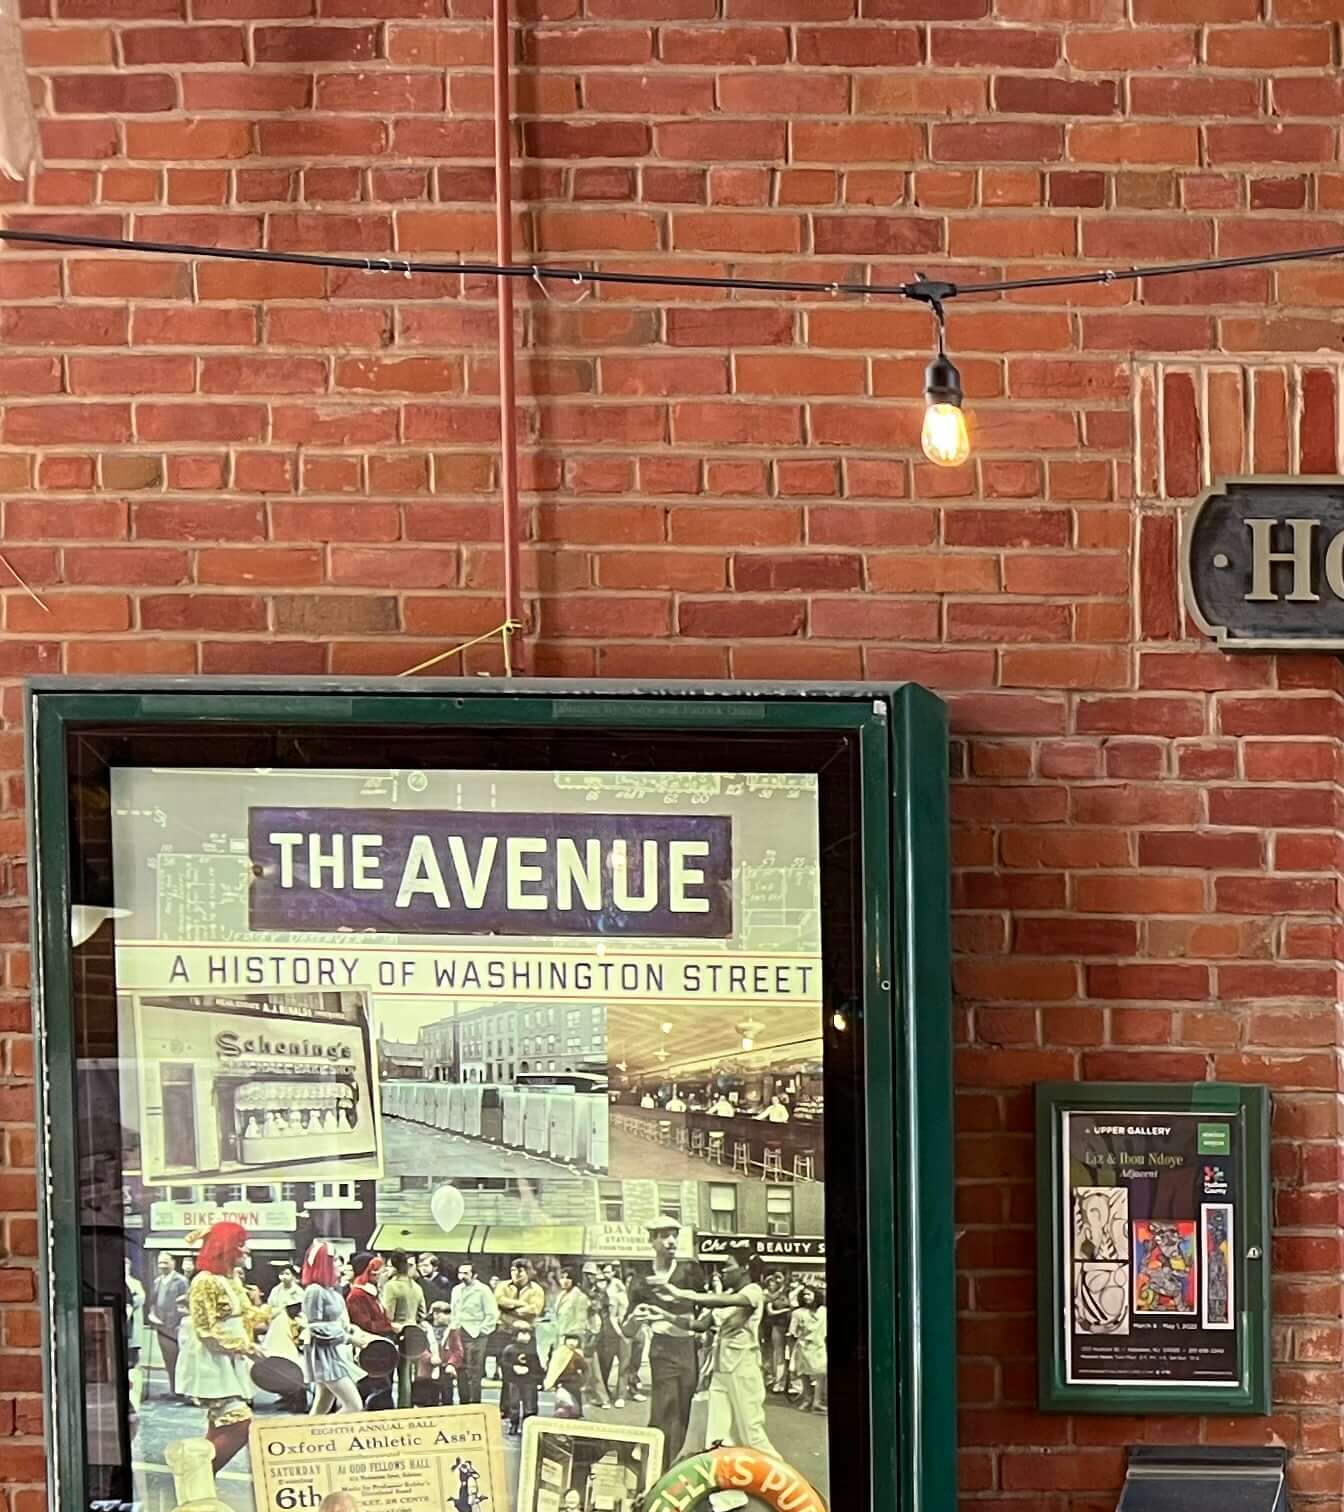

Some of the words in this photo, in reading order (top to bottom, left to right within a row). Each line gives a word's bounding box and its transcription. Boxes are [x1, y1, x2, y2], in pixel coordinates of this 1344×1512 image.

[269, 832, 384, 890] THE
[394, 834, 711, 914] AVENUE
[169, 955, 190, 984] A
[208, 955, 360, 986] HISTORY
[378, 960, 416, 987] OF
[434, 959, 664, 993] WASHINGTON
[683, 964, 814, 994] STREET
[1093, 1127, 1126, 1135] UPPER
[1127, 1127, 1172, 1136] GALLERY
[184, 1211, 215, 1225] BIKE
[223, 1212, 259, 1226] TOWN
[756, 1242, 812, 1253] BEAUTY
[358, 1423, 404, 1433] ANNUAL
[407, 1420, 437, 1430] BALL
[267, 1440, 337, 1457] Oxford
[349, 1434, 423, 1451] Athletic
[433, 1430, 483, 1446] Ass'n
[270, 1463, 322, 1478] SATURDAY
[275, 1485, 323, 1510] 6th
